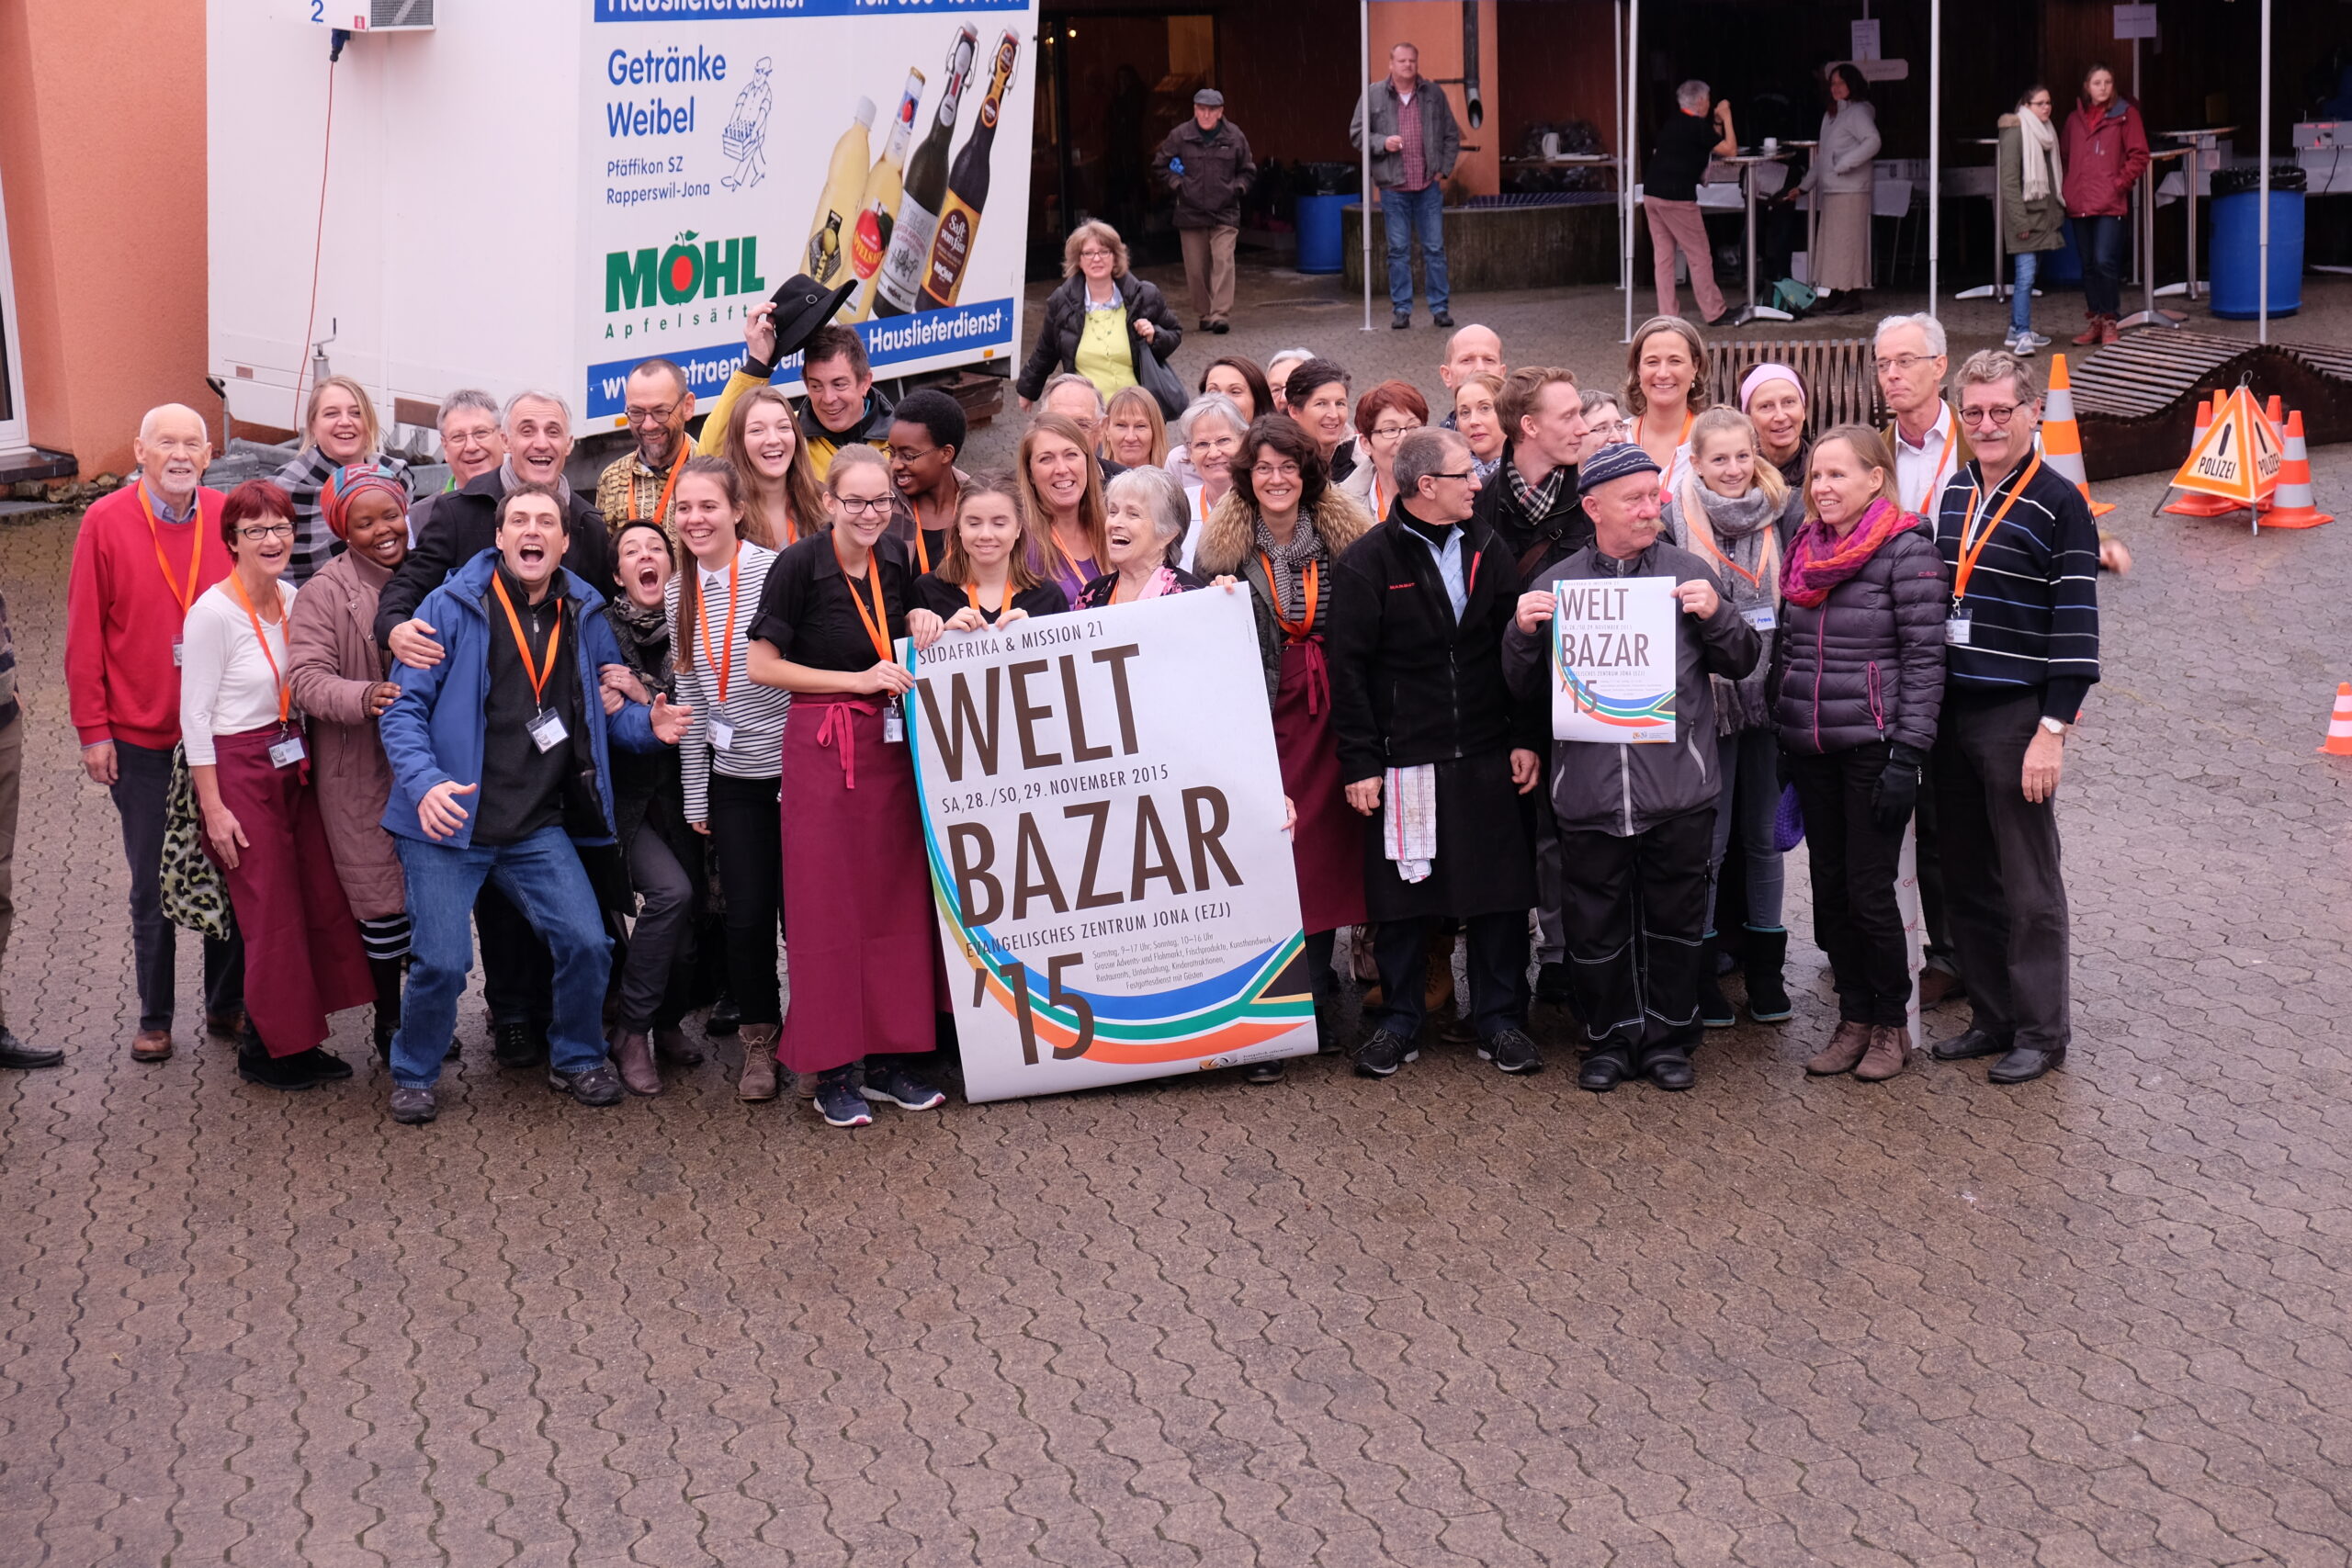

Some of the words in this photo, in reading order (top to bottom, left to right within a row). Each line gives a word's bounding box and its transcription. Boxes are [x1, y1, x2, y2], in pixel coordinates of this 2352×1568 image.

[311, 0, 324, 23] 2
[608, 44, 727, 85] Getränke
[606, 96, 695, 138] Weibel
[607, 157, 663, 177] Pfäffikon
[668, 156, 684, 173] SZ
[606, 181, 710, 208] Rapperswil-Jona
[605, 305, 748, 339] Apfelsäft
[869, 308, 1002, 354] Hauslieferdienst
[2198, 457, 2236, 479] POLIZEI
[1560, 588, 1629, 621] WELT
[919, 637, 1000, 665] SÜDAFRIKA
[1006, 637, 1015, 651] &
[1023, 625, 1081, 649] MISSION
[1088, 620, 1103, 637] 21
[1562, 633, 1650, 667] BAZAR
[915, 643, 1140, 783] WELT
[1050, 771, 1127, 795] NOVEMBER
[1132, 764, 1169, 784] 2015
[946, 785, 1244, 929] BAZAR
[966, 926, 1076, 958] EVANGELISCHES
[1080, 915, 1148, 940] ZENTRUM
[1153, 908, 1189, 928] JONA
[1195, 901, 1232, 922] (EZJ)
[1142, 954, 1152, 963] und
